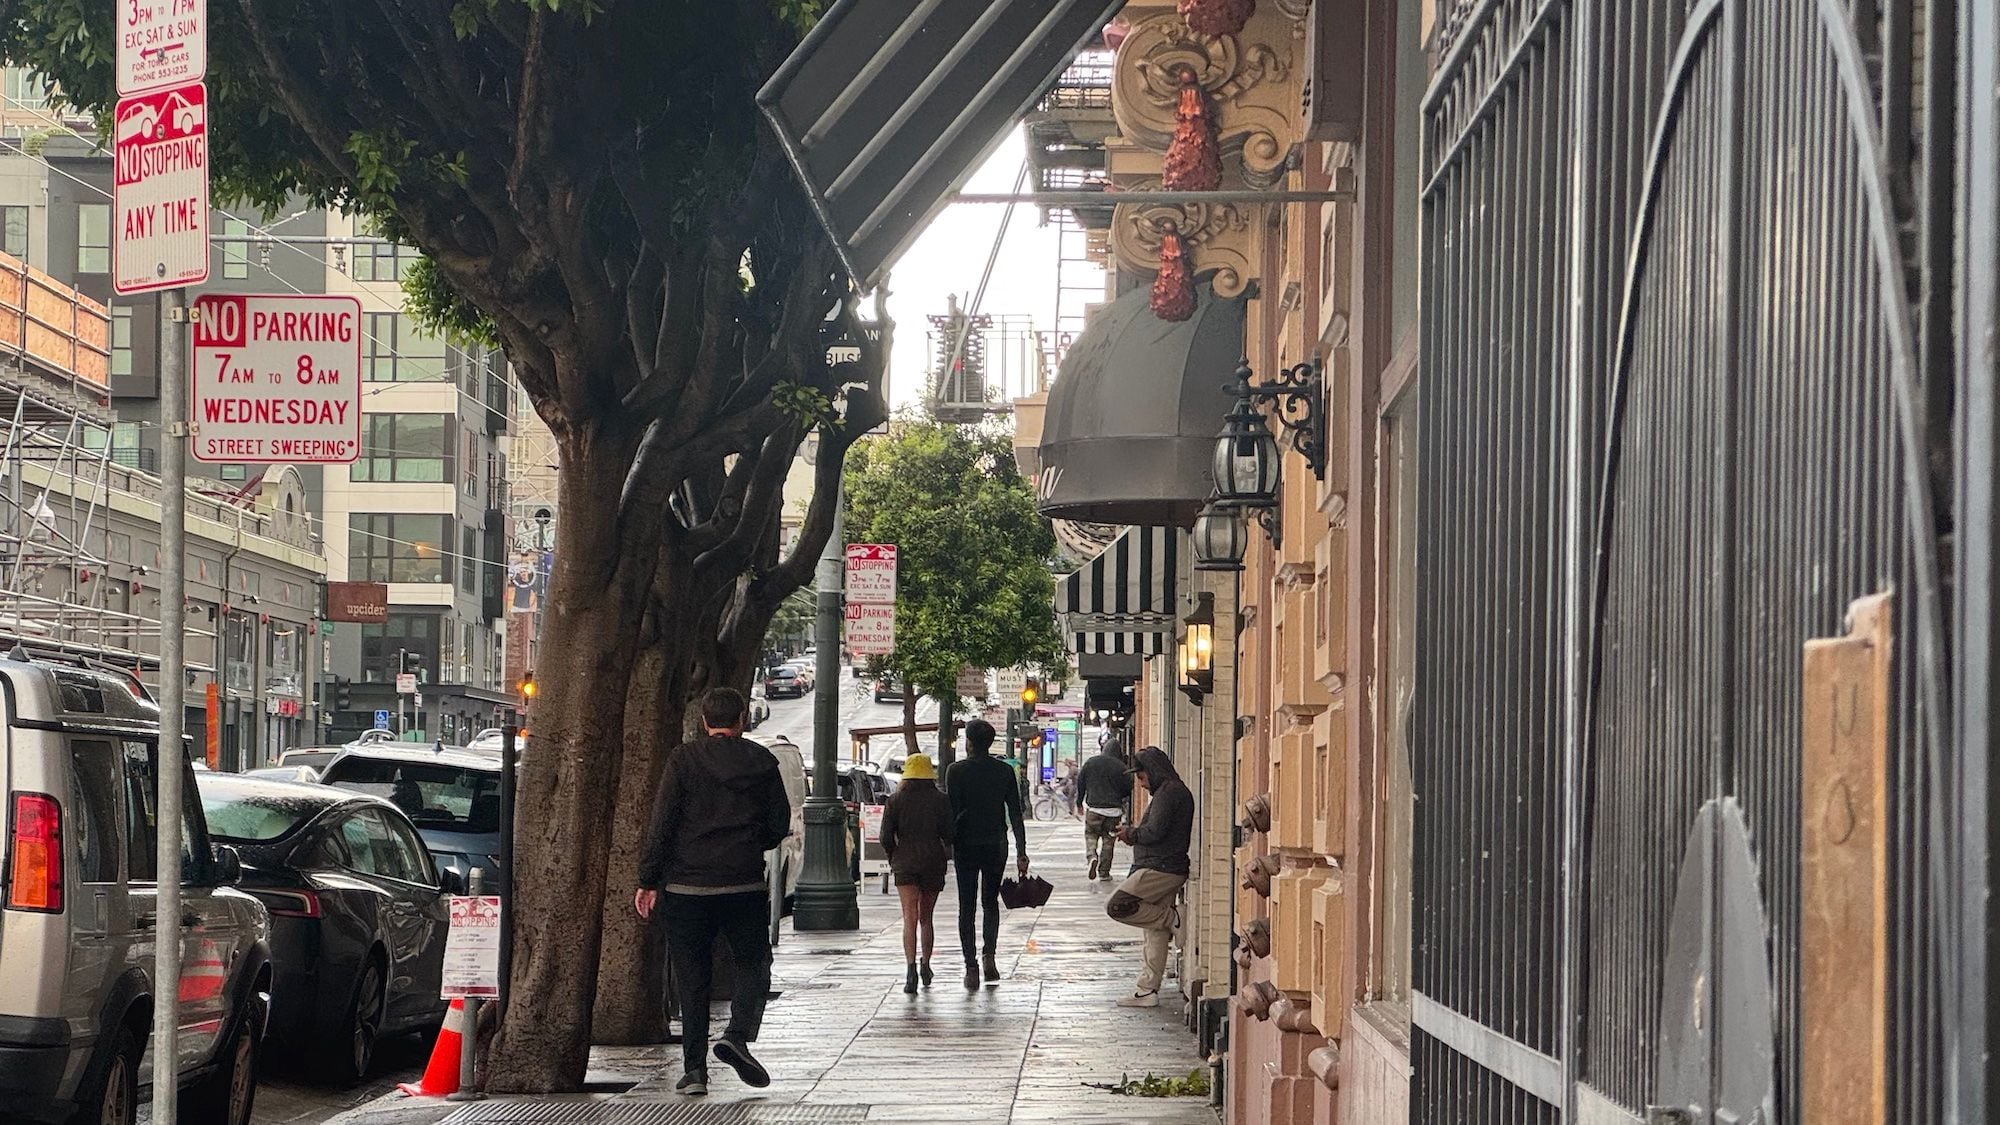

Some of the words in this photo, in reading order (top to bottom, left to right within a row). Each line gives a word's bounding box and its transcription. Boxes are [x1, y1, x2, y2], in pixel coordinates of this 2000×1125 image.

[126, 31, 143, 49] EXC
[146, 26, 164, 44] SAT
[167, 24, 174, 40] &
[177, 18, 197, 38] SUN
[132, 62, 145, 72] FOR
[171, 52, 189, 63] CARS
[133, 71, 156, 83] PHONE
[119, 143, 141, 182] NO
[143, 137, 202, 178] STOPPING
[125, 205, 156, 241] ANY
[163, 198, 198, 235] TIME
[200, 300, 240, 342] NO
[253, 312, 352, 343] PARKING
[268, 373, 281, 384] TO
[204, 398, 349, 425] WEDNESDAY
[207, 439, 263, 455] STREET
[271, 440, 345, 456] SWEEPING
[847, 558, 860, 570] NO
[861, 561, 894, 570] STOPPING
[347, 603, 385, 617] upcider
[847, 605, 861, 618] NO
[863, 609, 892, 619] PARKING
[848, 634, 891, 642] WEDNESDAY
